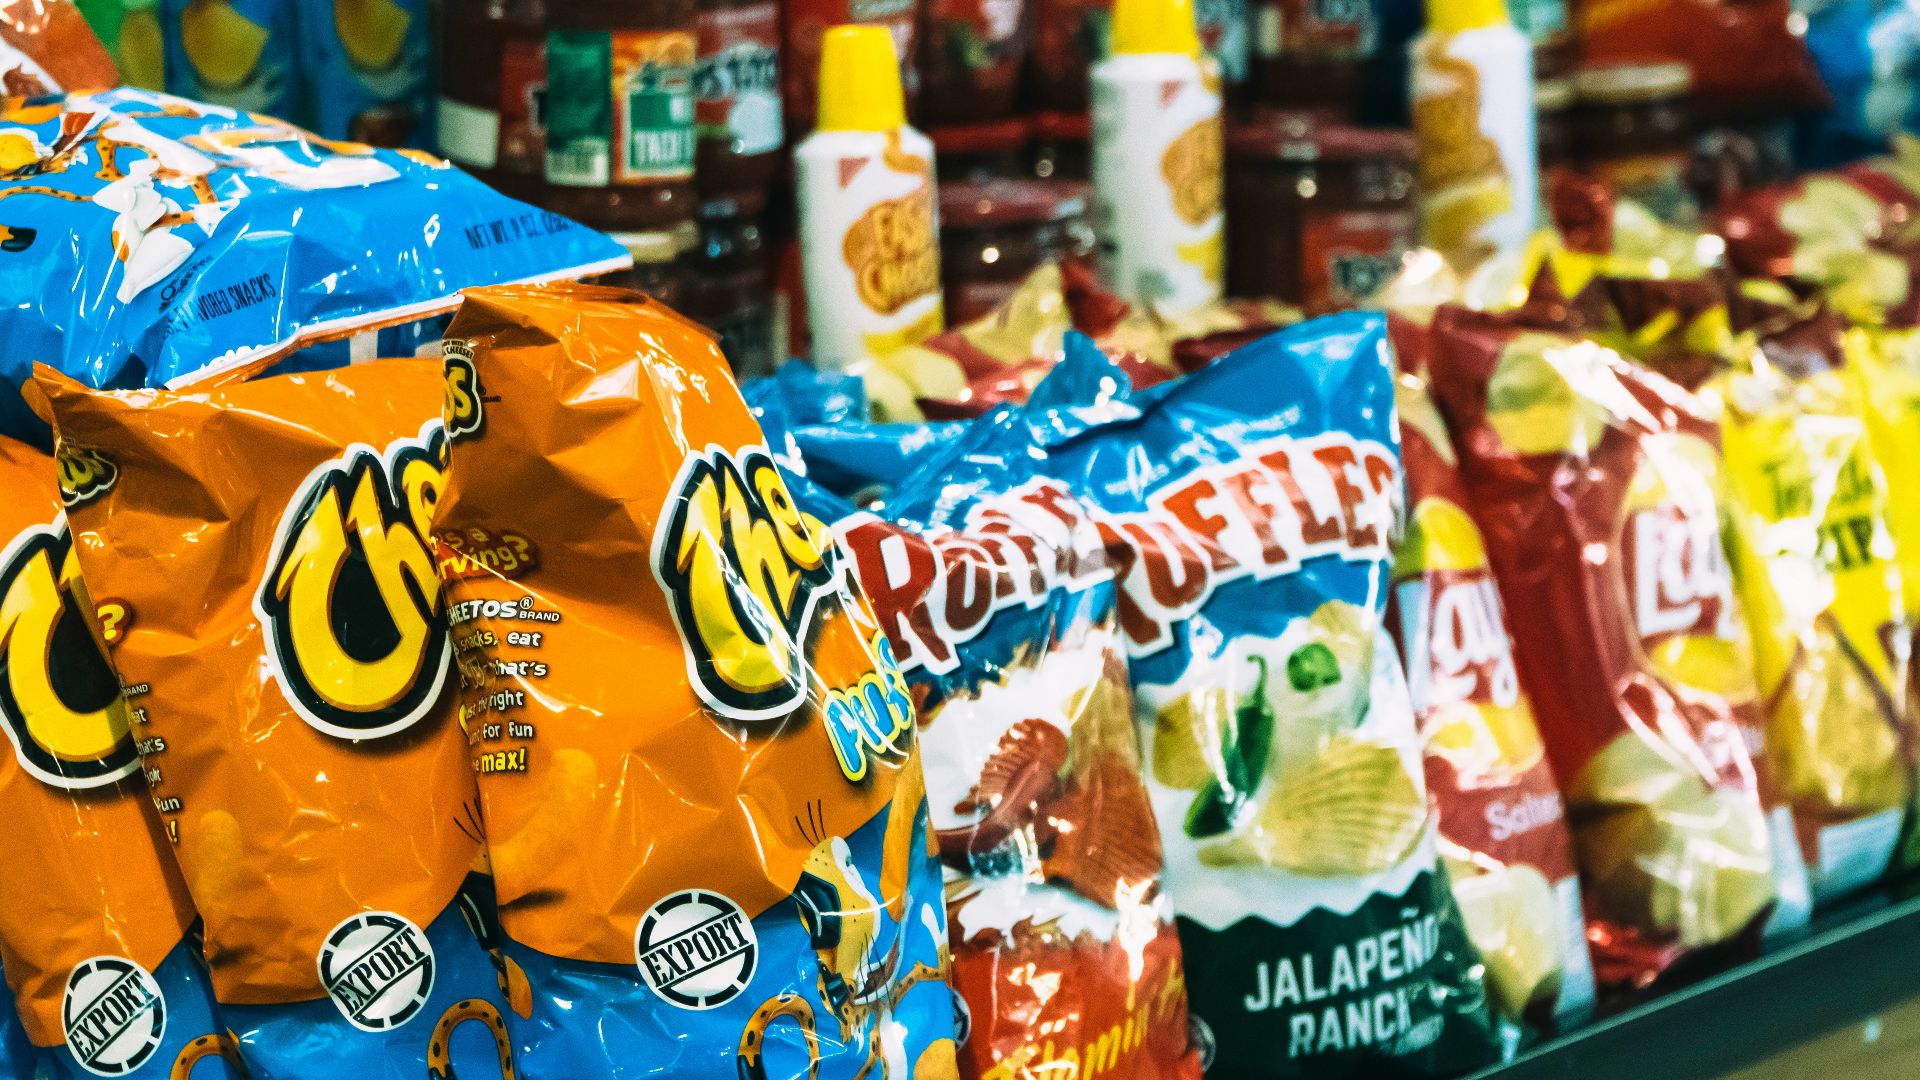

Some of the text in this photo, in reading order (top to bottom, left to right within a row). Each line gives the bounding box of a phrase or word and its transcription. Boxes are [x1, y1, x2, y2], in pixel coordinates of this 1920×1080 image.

[227, 272, 277, 312] SNACKS
[519, 610, 560, 622] BRAND
[507, 632, 542, 647] eat
[489, 689, 524, 711] right
[483, 722, 501, 739] for
[508, 721, 533, 738] fun
[481, 748, 525, 773] max!
[640, 912, 750, 989] EXPORT
[331, 926, 426, 1017] EXPORT
[69, 969, 156, 1064] EXPORT
